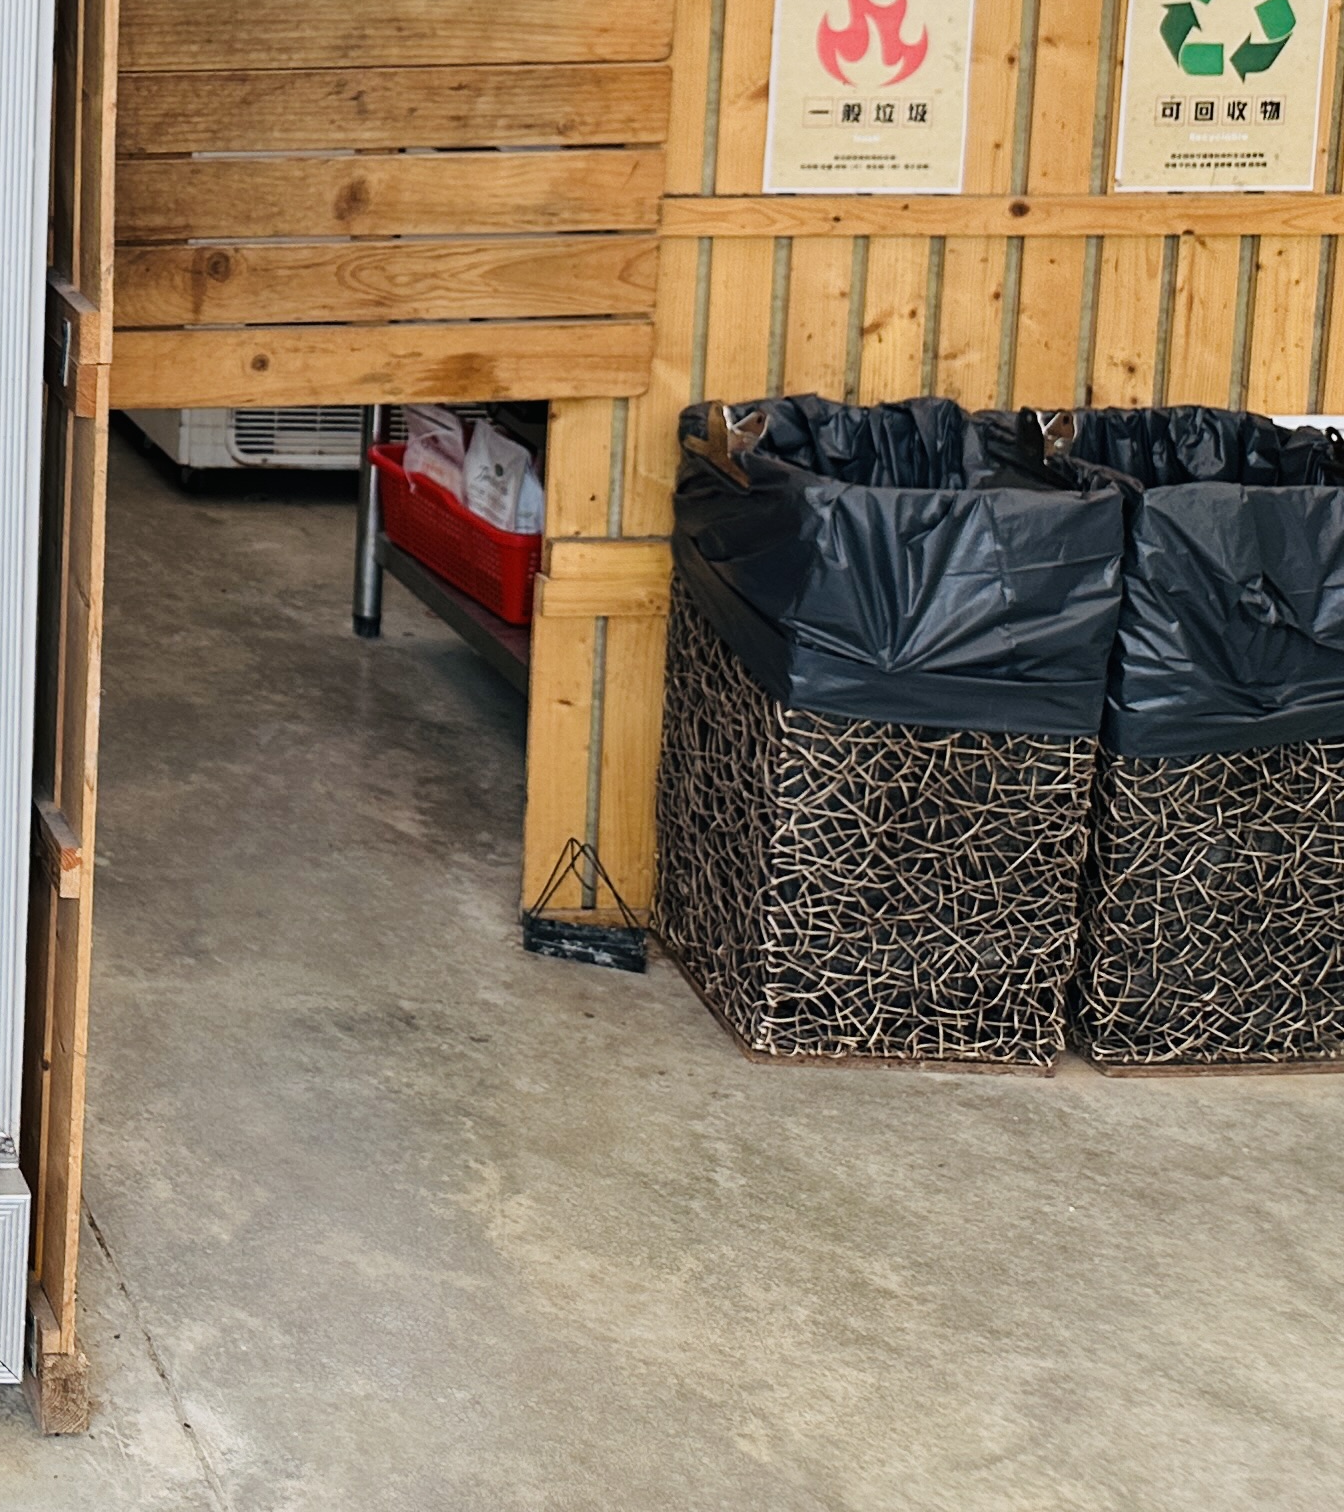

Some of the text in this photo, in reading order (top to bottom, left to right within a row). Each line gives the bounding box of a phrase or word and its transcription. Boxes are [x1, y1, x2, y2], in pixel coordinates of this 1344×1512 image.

[808, 102, 928, 123] 一般垃圾
[1161, 100, 1281, 121] 可回收物
